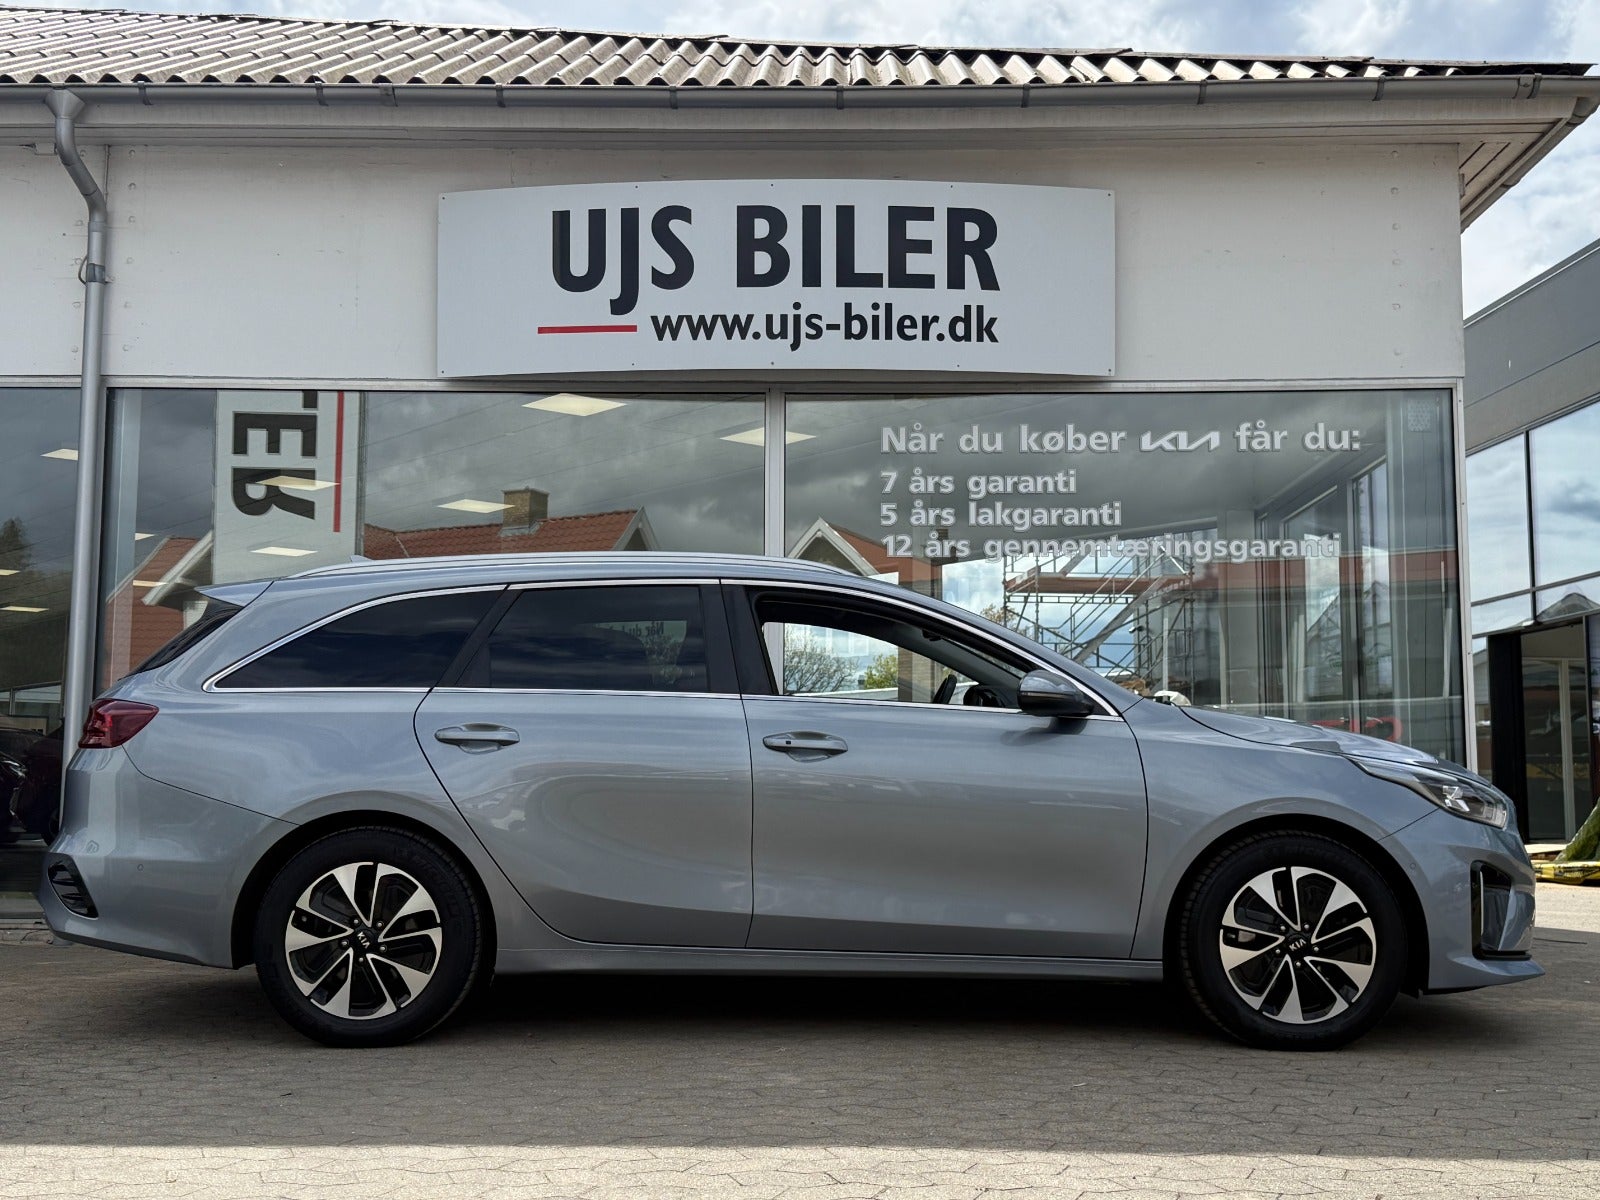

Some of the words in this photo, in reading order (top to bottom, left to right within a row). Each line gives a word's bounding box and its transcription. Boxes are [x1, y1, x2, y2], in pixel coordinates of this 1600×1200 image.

[551, 206, 694, 315] UJS
[736, 205, 1000, 291] BILER
[650, 302, 999, 352] www.ujs-biler.dk
[879, 422, 943, 454] Når
[958, 424, 1003, 453] du
[1019, 423, 1127, 454] køber
[1235, 421, 1288, 452] får
[1304, 422, 1362, 452] du:
[880, 472, 897, 494] 7
[909, 468, 955, 495] års
[967, 469, 1077, 498] garanti
[880, 502, 897, 527] 5
[909, 500, 955, 527] års
[968, 501, 1122, 531] lakgaranti
[881, 535, 912, 558] 12
[924, 532, 970, 559] års
[984, 532, 1342, 565] gennemtæringsgaranti
[356, 931, 370, 949] KIA
[1288, 938, 1307, 951] KIA
